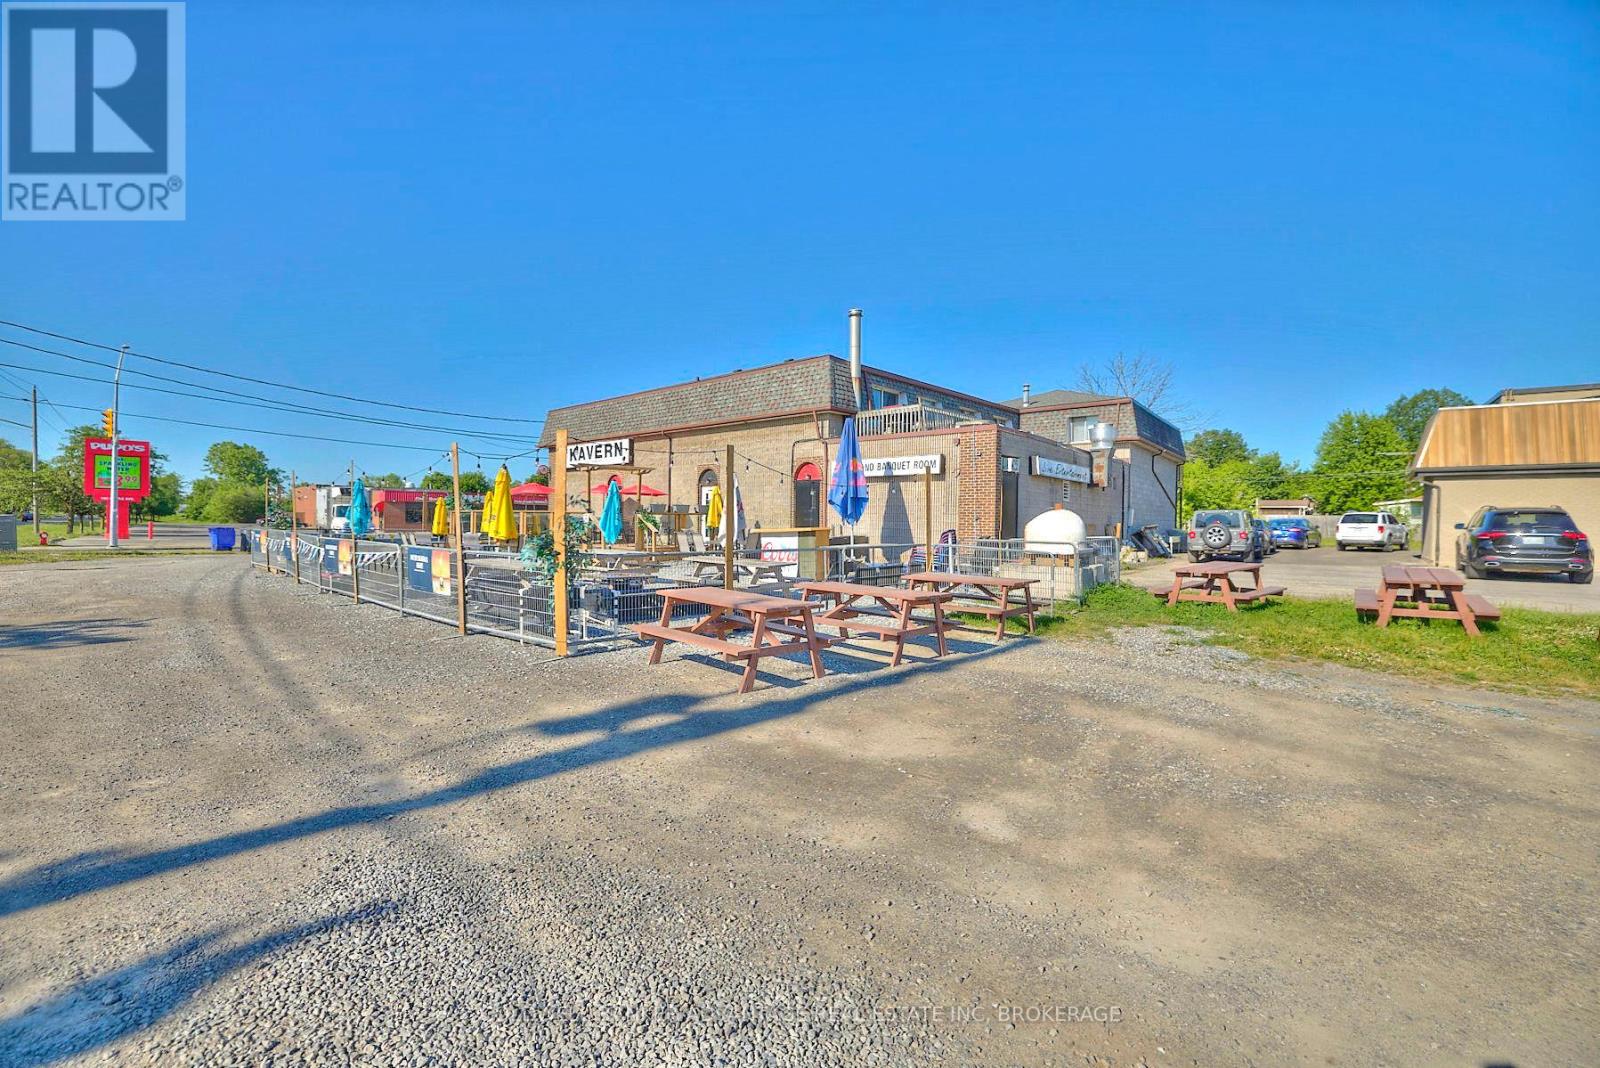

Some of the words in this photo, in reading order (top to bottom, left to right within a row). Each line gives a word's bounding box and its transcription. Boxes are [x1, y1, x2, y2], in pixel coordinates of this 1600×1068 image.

[569, 441, 623, 462] KAVERN
[864, 463, 875, 472] ND
[877, 460, 911, 471] BANQUET
[914, 459, 937, 470] ROOM
